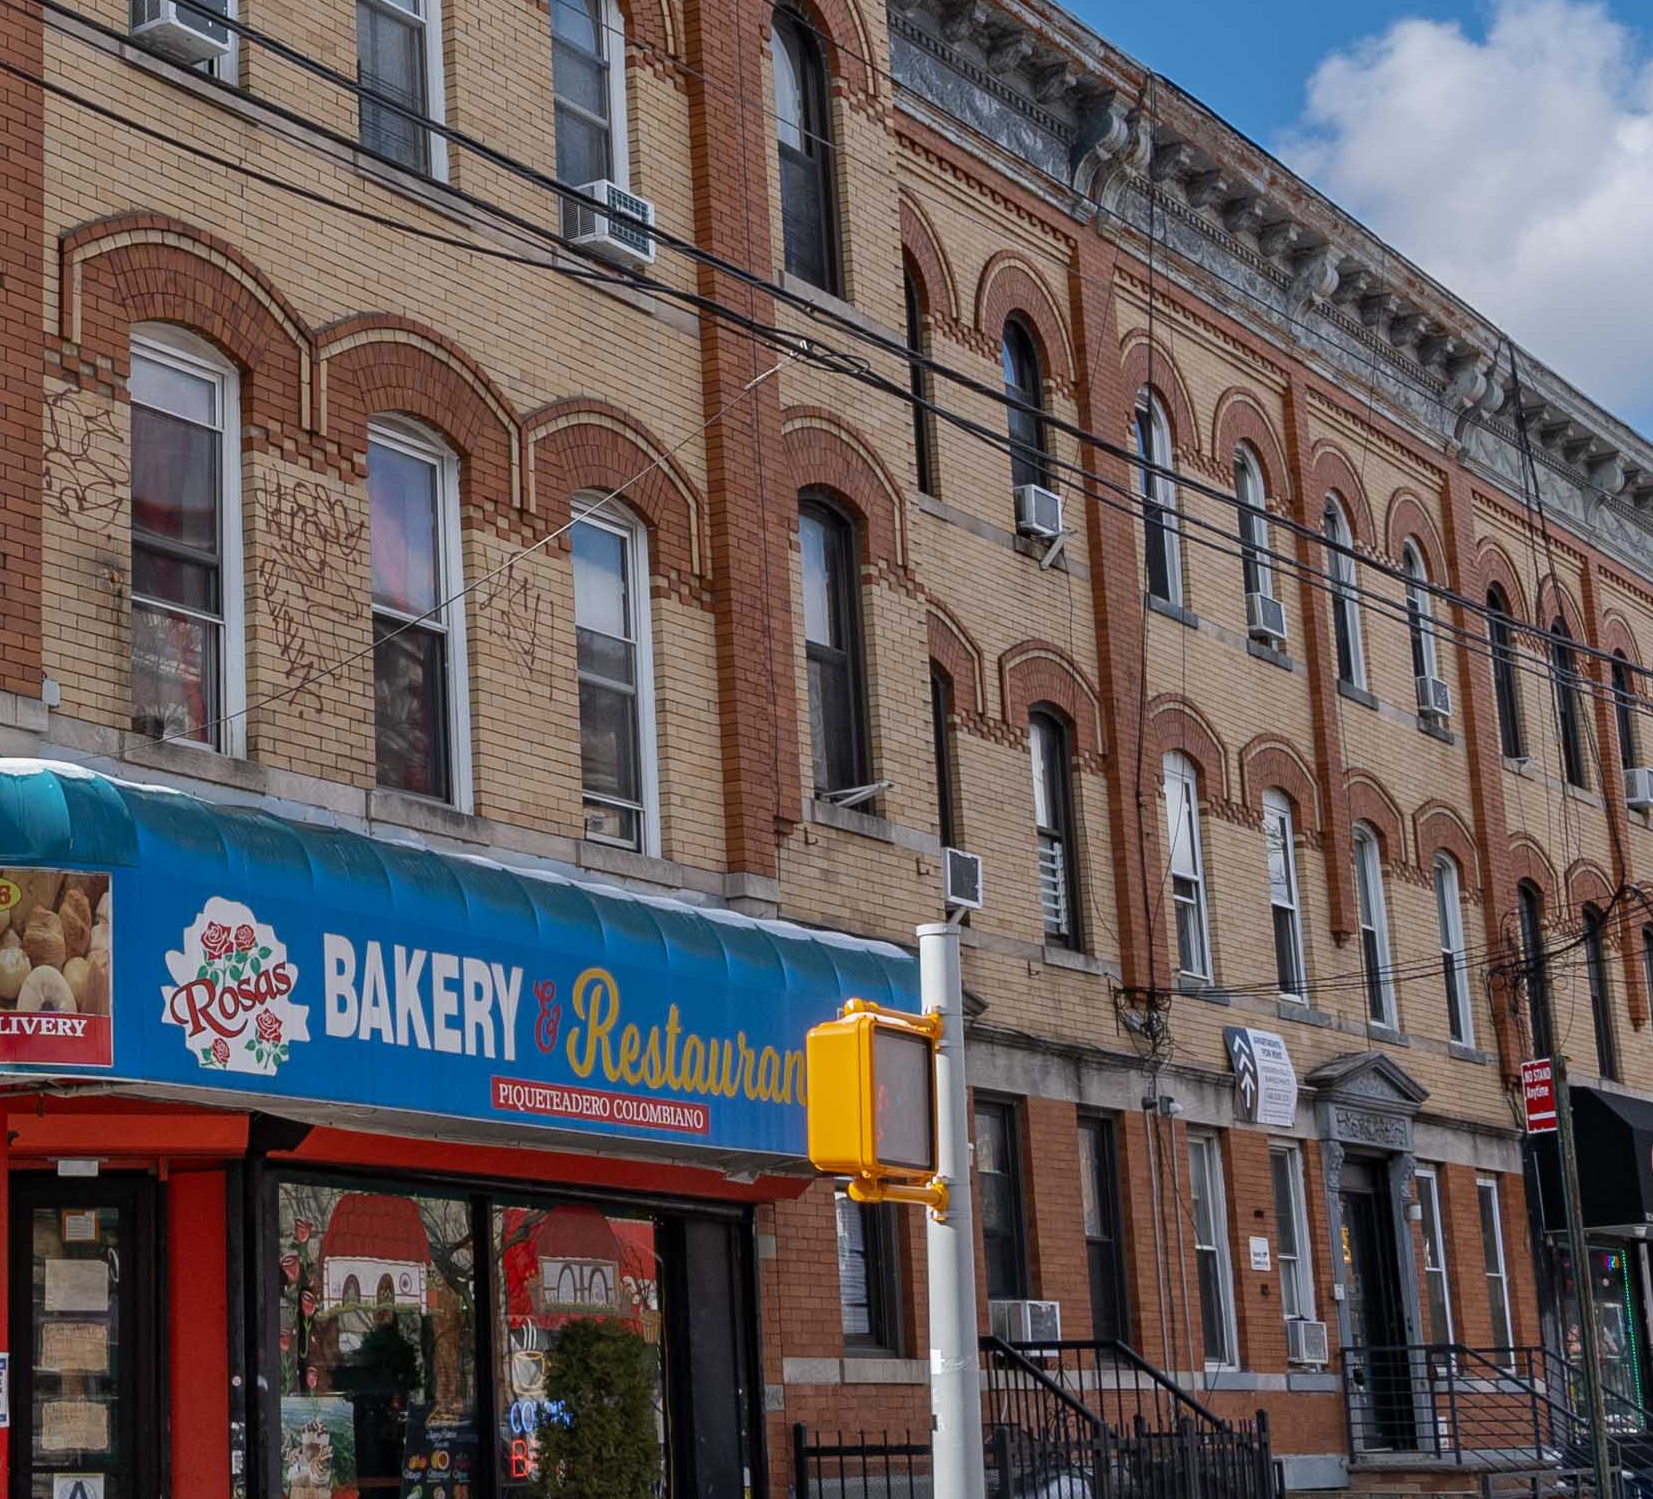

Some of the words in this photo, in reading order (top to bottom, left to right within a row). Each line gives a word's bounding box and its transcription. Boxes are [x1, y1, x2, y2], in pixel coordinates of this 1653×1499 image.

[170, 960, 292, 1039] Rosas
[323, 932, 524, 1062] BAKERY
[534, 978, 562, 1054] &
[566, 967, 808, 1107] Restauran
[498, 1083, 611, 1119] PIQUETEADERO
[613, 1100, 704, 1129] COLOMBIANO
